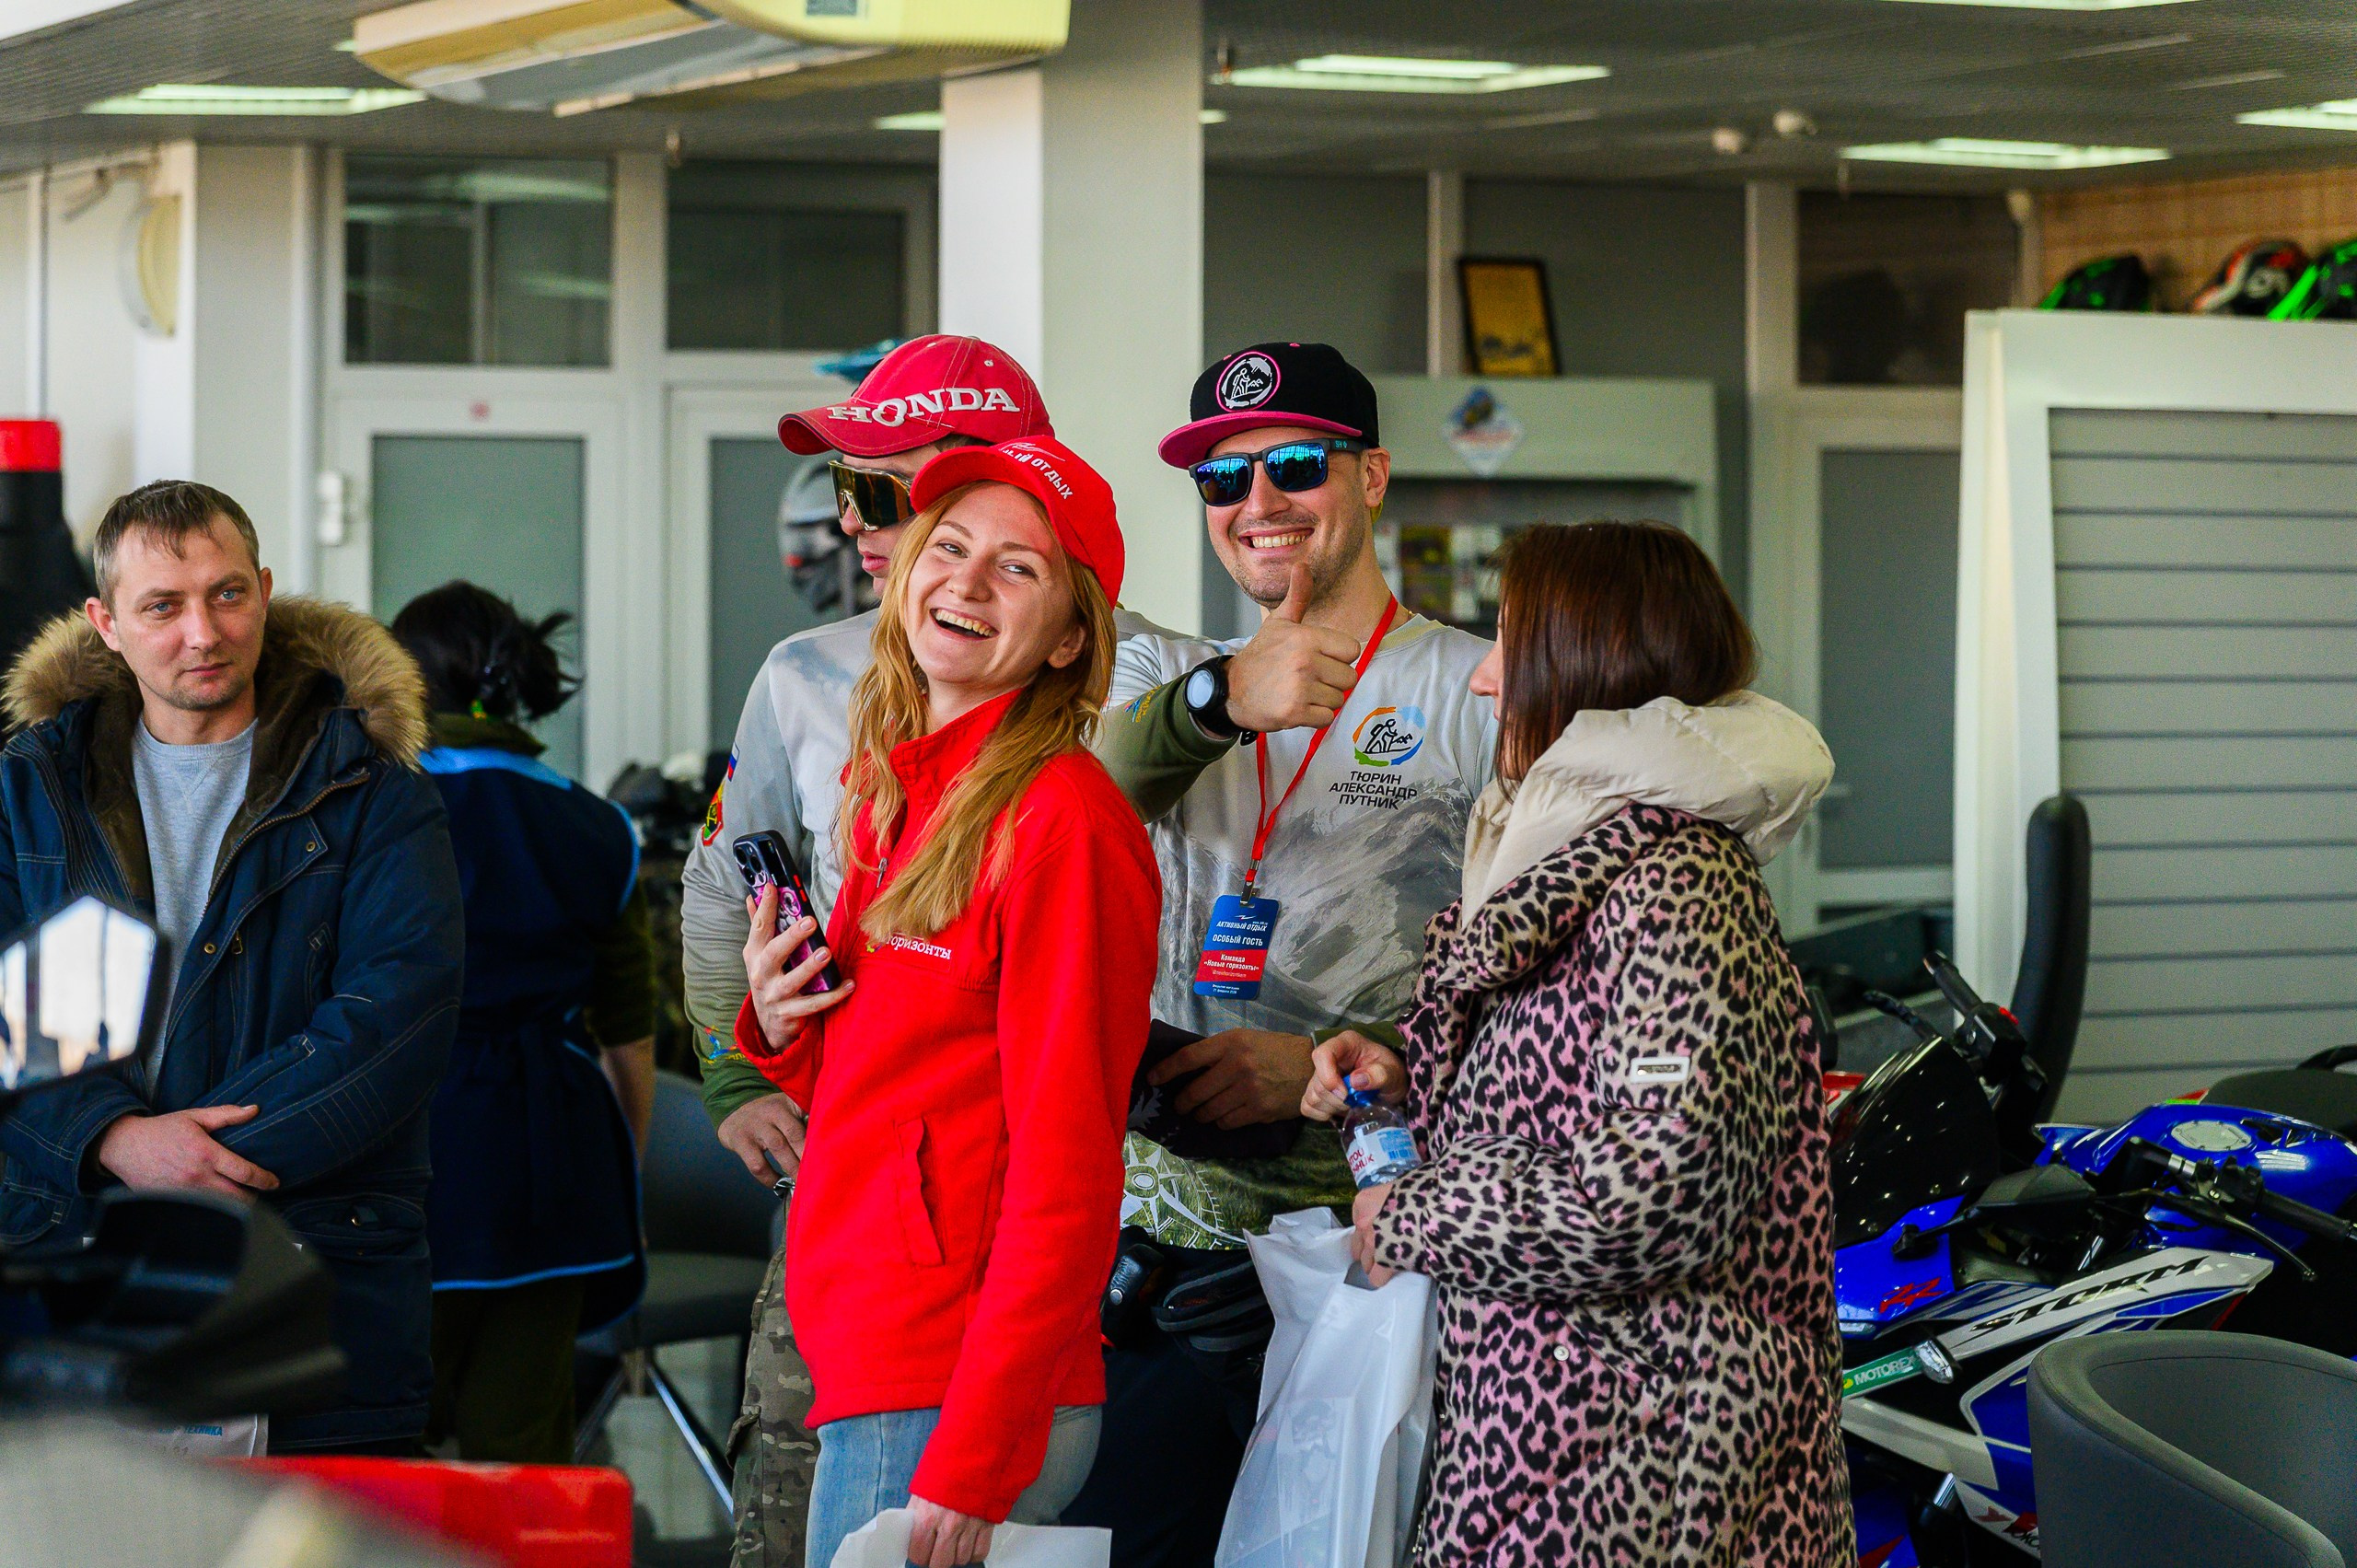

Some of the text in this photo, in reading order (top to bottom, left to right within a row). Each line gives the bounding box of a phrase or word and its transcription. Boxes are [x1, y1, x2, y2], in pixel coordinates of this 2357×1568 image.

[827, 387, 1020, 427] HONDA
[1030, 458, 1074, 500] ОТДЫХ
[1350, 770, 1402, 785] ТЮРИН
[1329, 782, 1418, 801] АЛЕКСАНДР
[1339, 794, 1400, 811] ПУТНИК
[1216, 921, 1247, 930] АКТИВНЫЙ
[1247, 923, 1268, 932] ОТДЫХ
[1212, 934, 1263, 947] ОСОБЫЙ ГОСТЬ
[1220, 954, 1246, 963] Команда
[1853, 1354, 1916, 1386] MOTOREX
